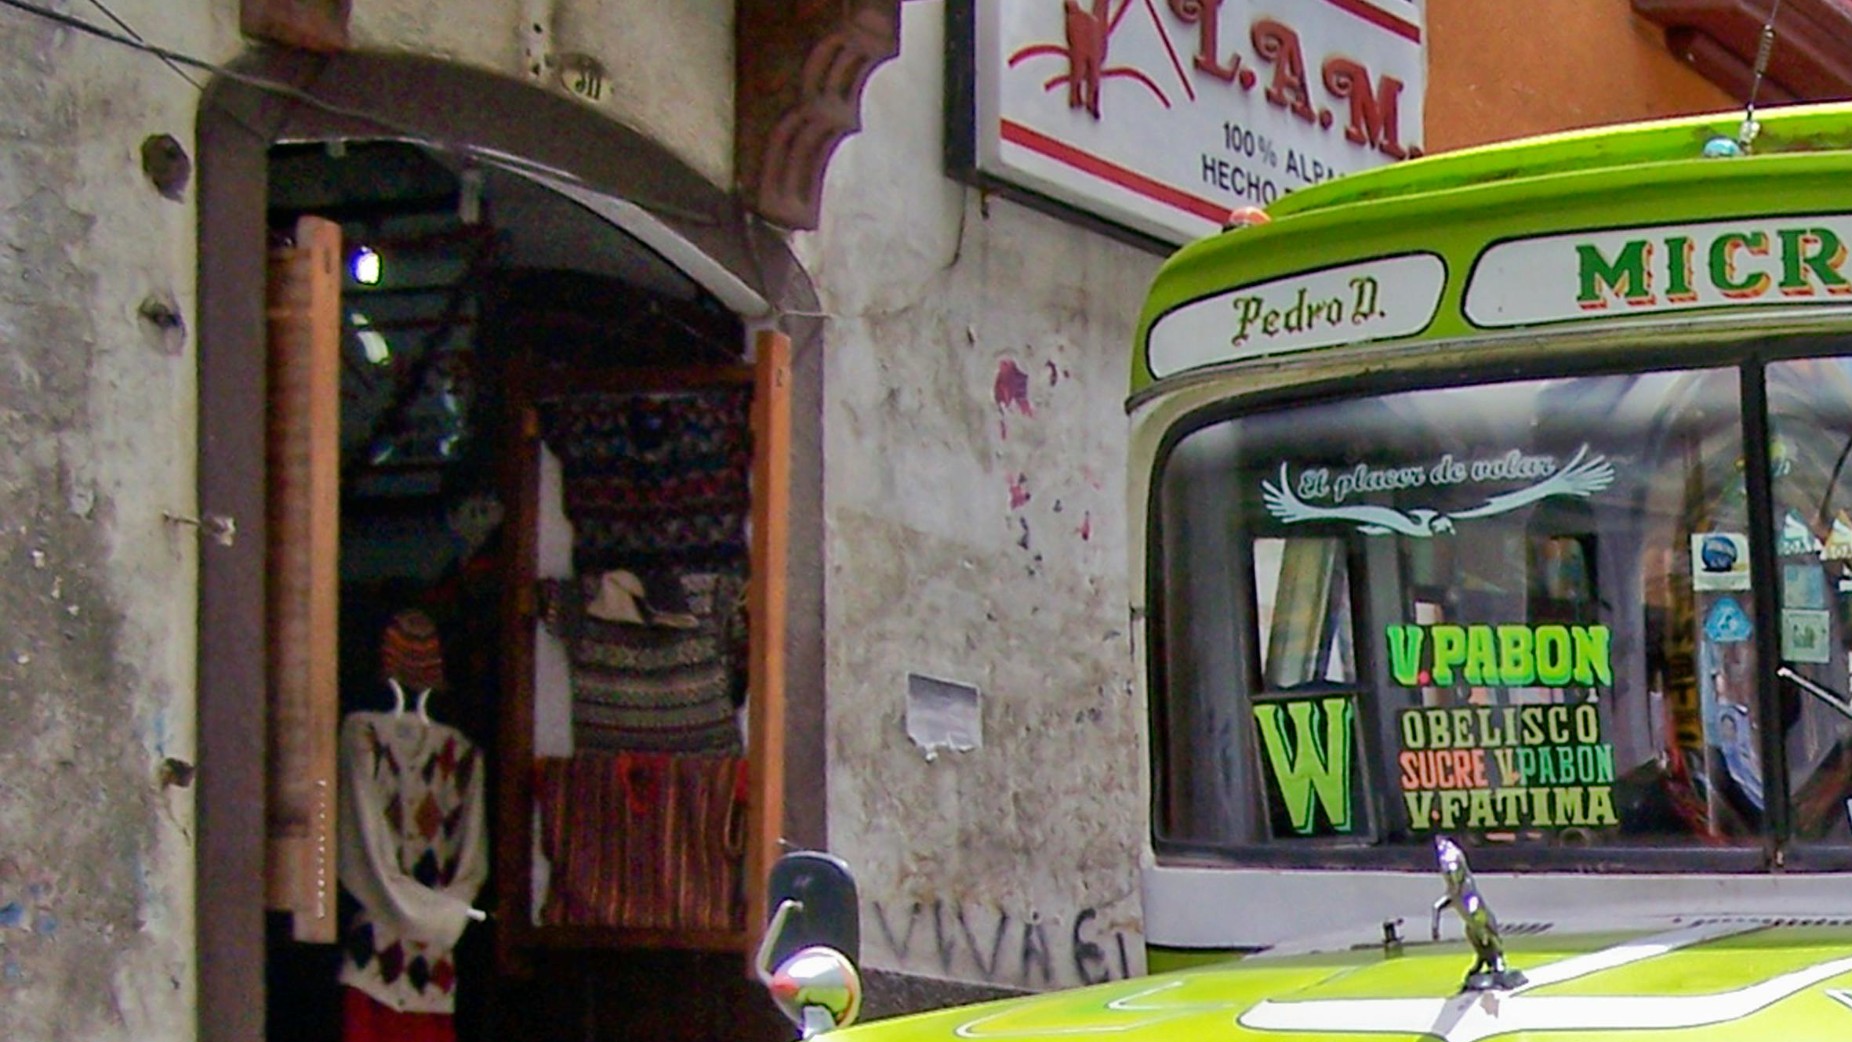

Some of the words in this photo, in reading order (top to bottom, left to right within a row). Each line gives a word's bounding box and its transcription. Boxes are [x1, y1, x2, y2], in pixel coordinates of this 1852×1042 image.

[1202, 153, 1276, 204] HECHO
[1286, 149, 1347, 184] ALPA
[1231, 288, 1343, 348] Pedro
[1349, 276, 1386, 326] D.
[1298, 467, 1331, 500] El
[1333, 463, 1426, 503] placer
[1430, 454, 1468, 485] de
[1471, 449, 1557, 482] volar
[1402, 704, 1599, 749] OBELISCO
[1254, 697, 1355, 834] W
[1400, 749, 1489, 790] SUCRE
